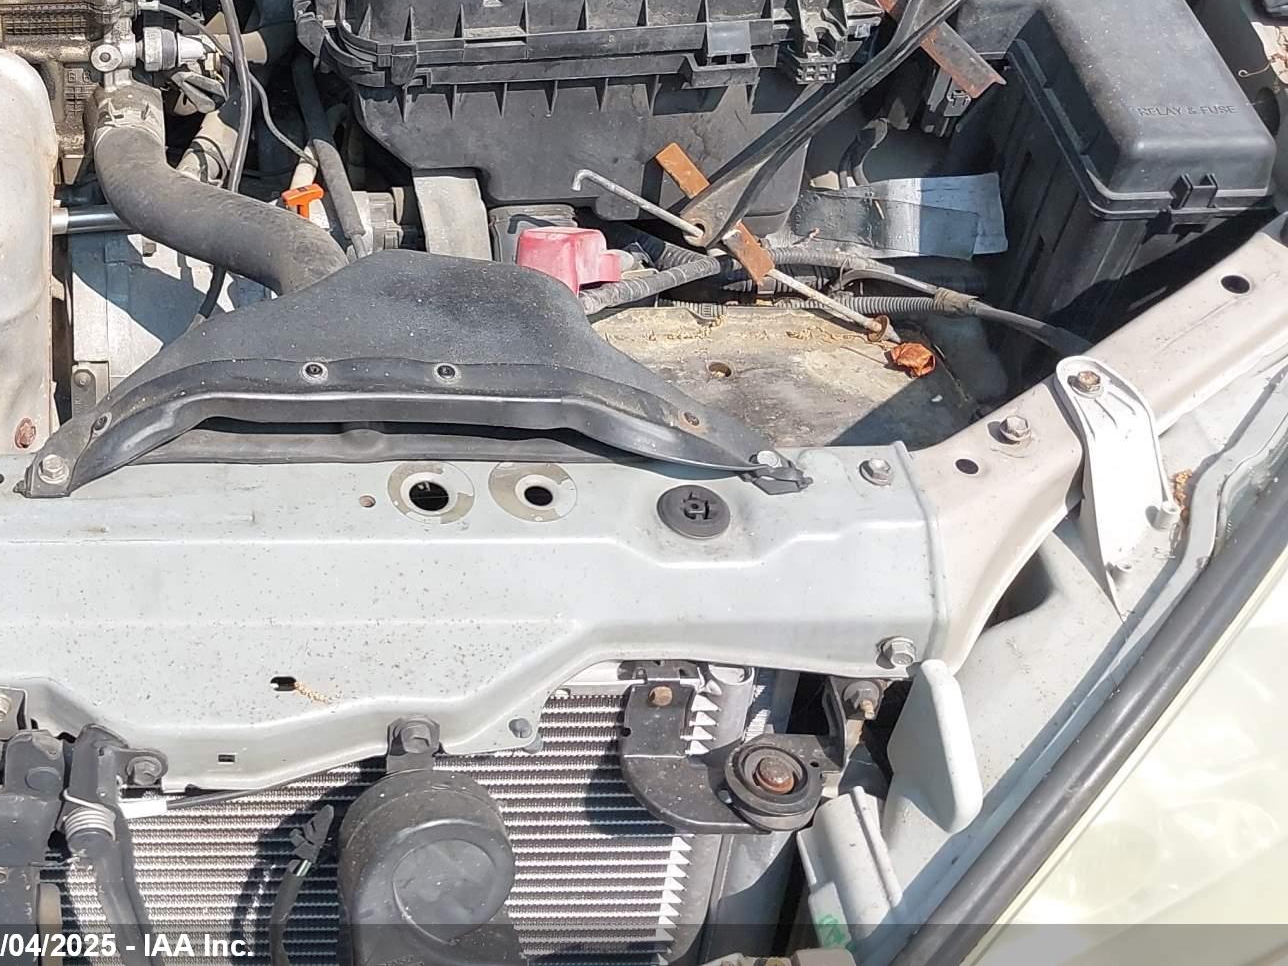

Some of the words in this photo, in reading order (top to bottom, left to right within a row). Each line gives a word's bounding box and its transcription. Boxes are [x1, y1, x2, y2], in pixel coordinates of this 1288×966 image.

[1137, 106, 1182, 116] RELAY
[1187, 107, 1198, 115] &
[1200, 105, 1236, 115] FUSE
